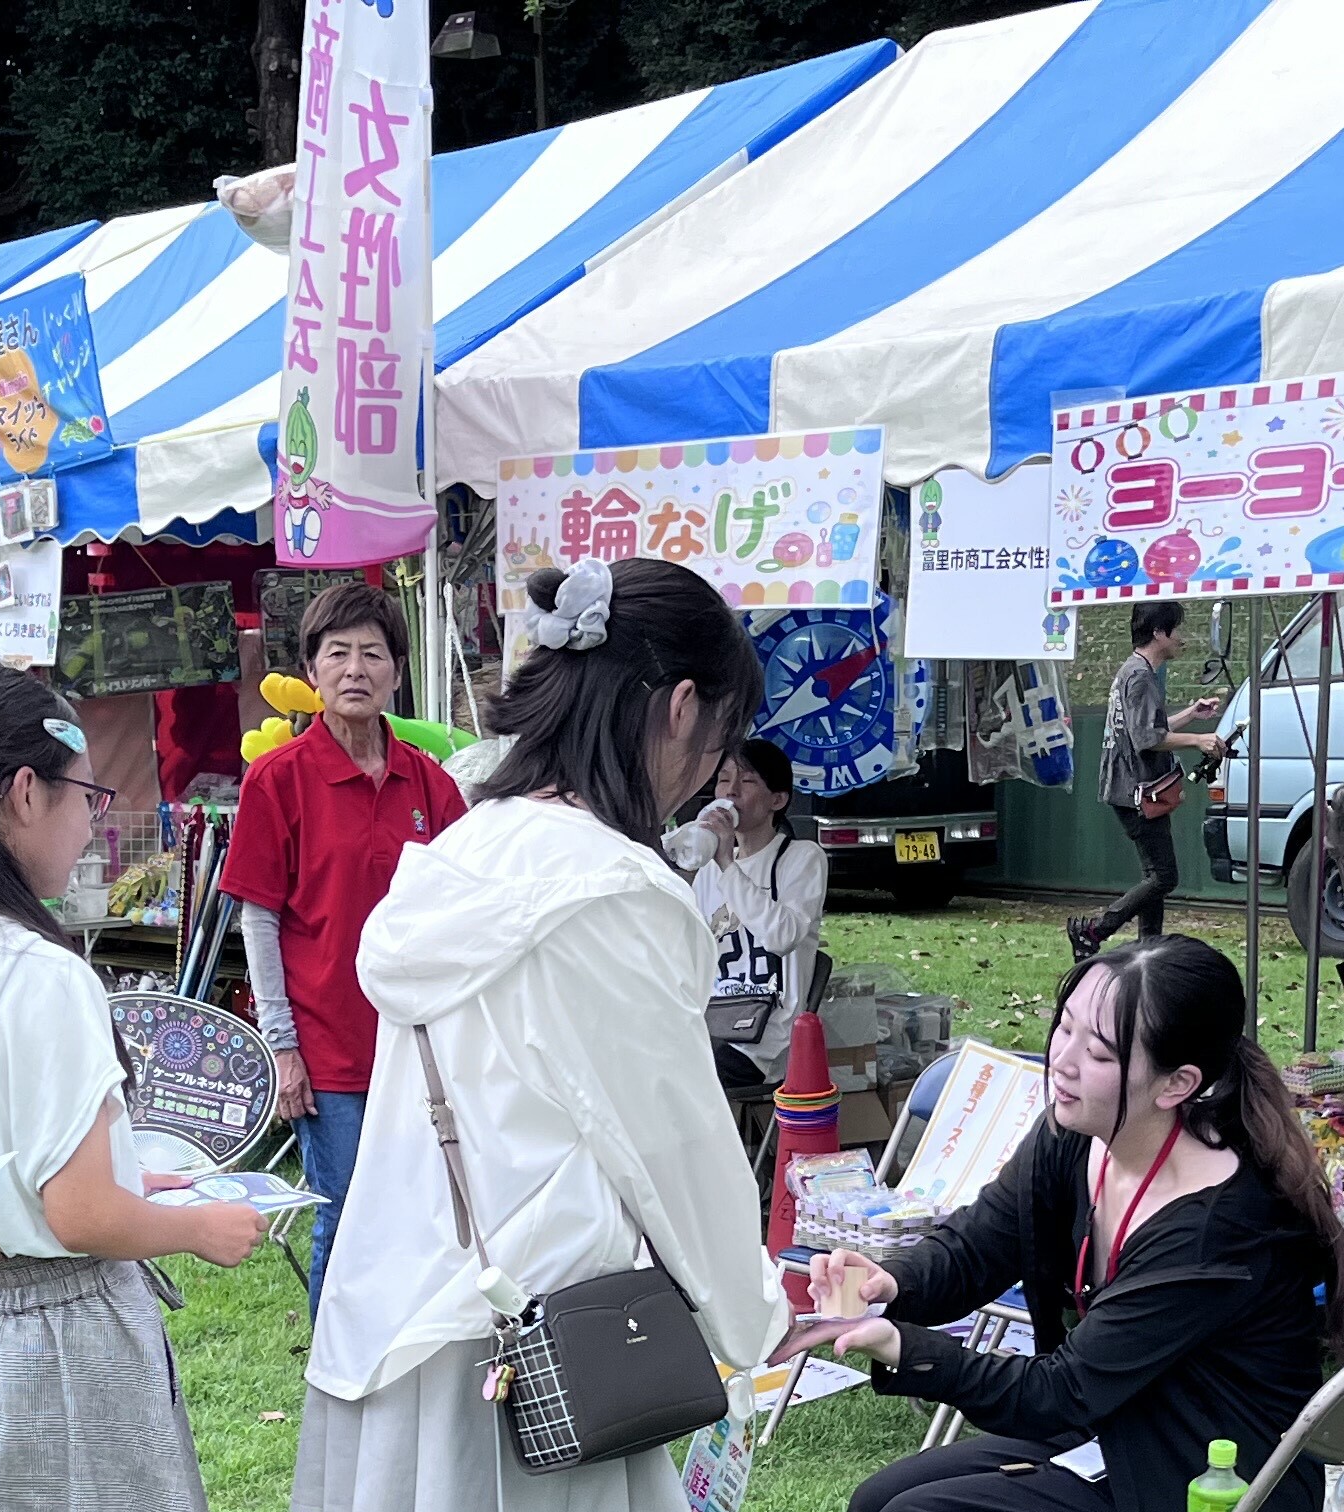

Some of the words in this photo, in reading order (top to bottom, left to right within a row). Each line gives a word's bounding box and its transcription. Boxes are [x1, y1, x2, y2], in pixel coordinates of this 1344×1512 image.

[559, 480, 794, 563] 輪なげ
[921, 545, 1050, 572] 富里市商工会女性
[152, 1066, 253, 1099] ケーブルネット296
